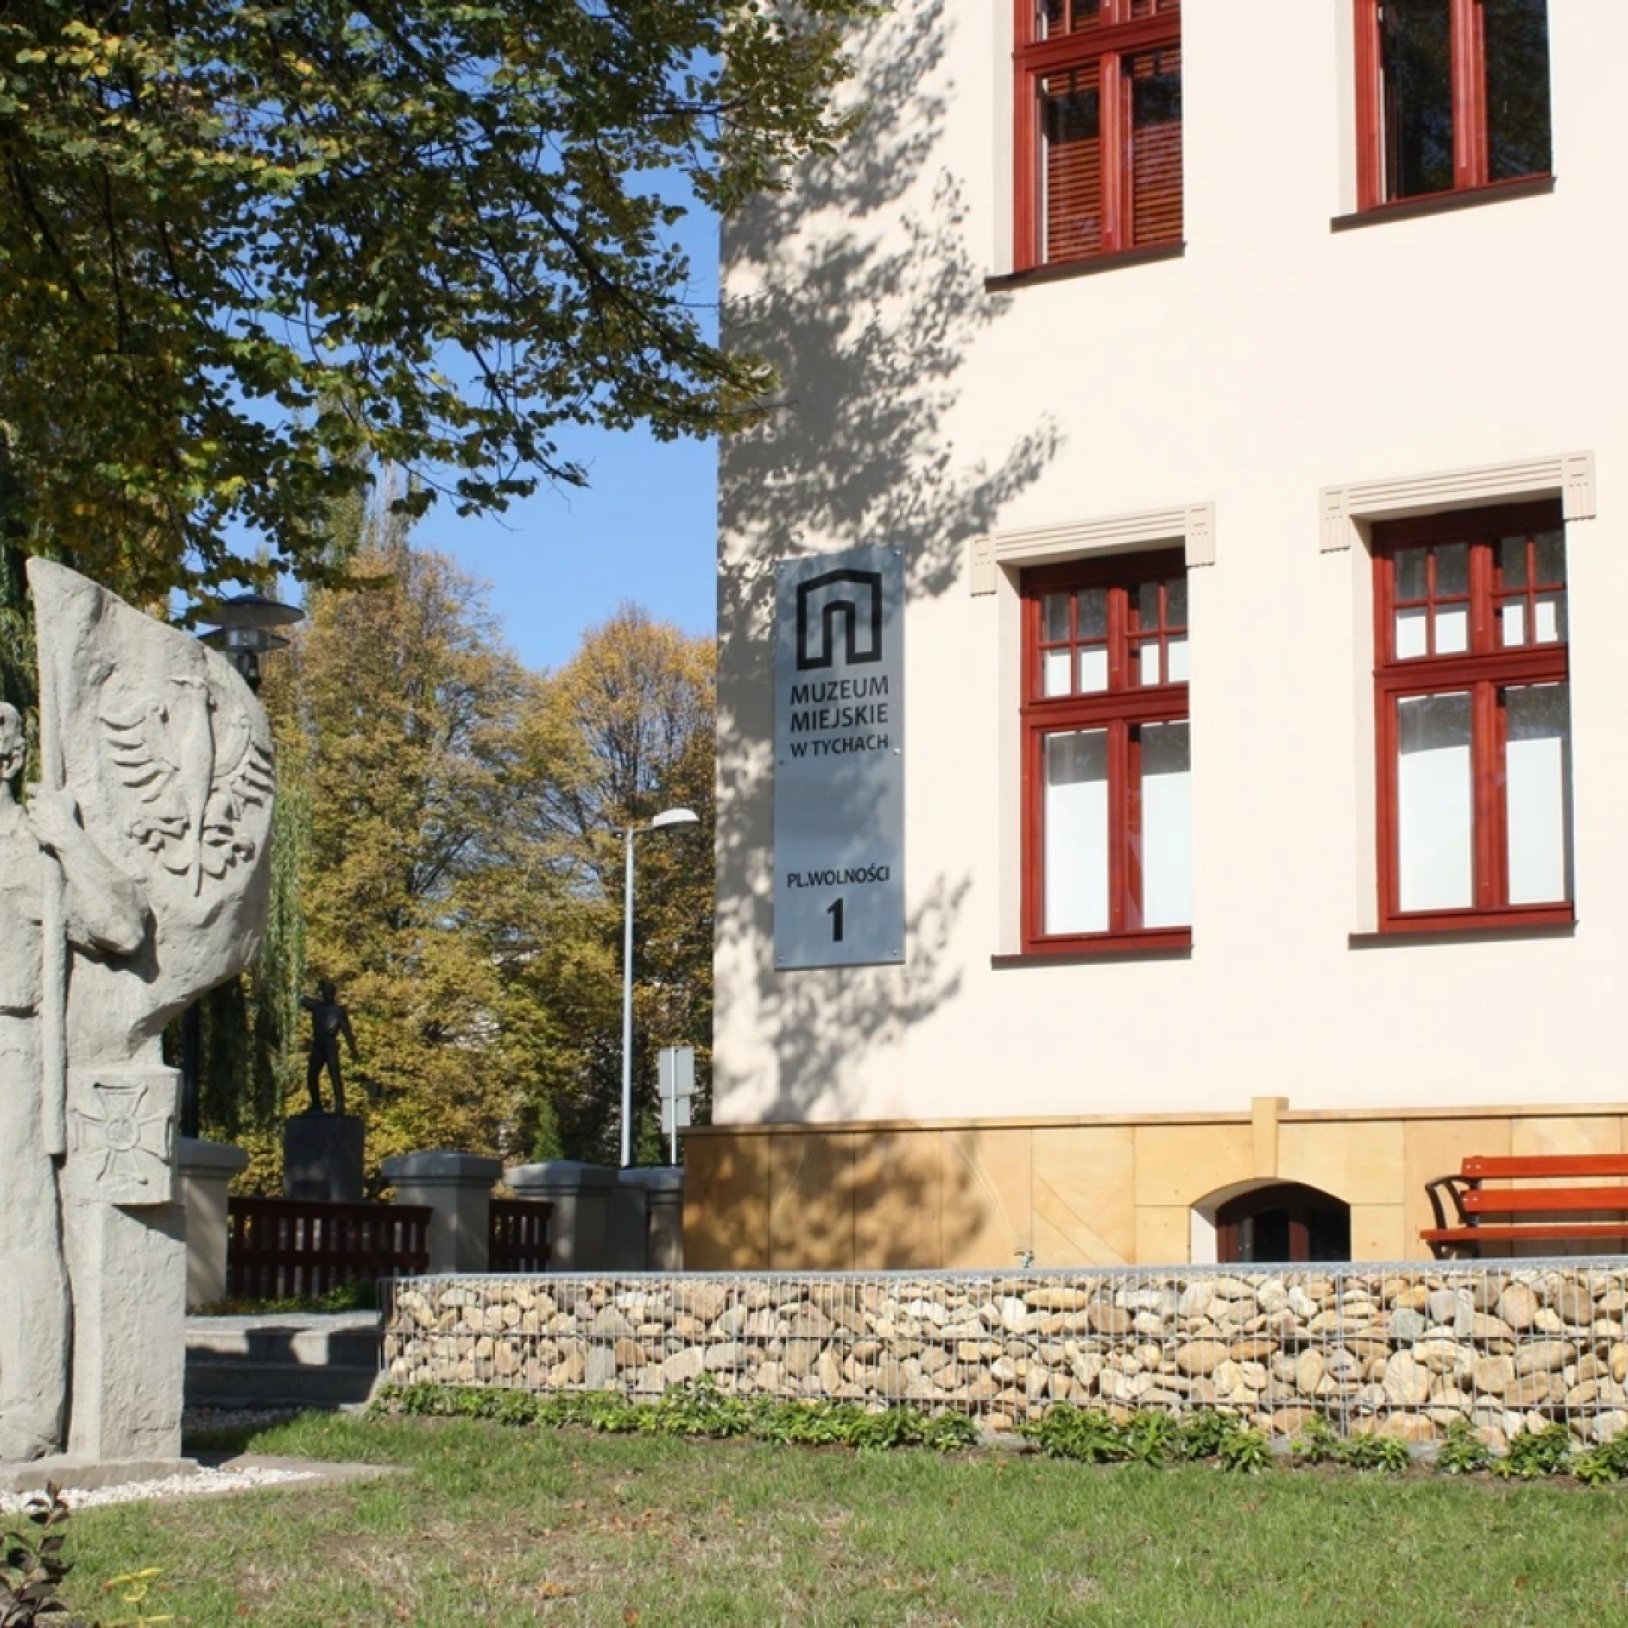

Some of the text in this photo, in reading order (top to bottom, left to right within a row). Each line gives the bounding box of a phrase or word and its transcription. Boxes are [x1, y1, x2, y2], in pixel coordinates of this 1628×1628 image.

[790, 674, 889, 706] MUZEUM
[790, 702, 889, 733] MIEJSKIE
[790, 733, 889, 758] W TYCHACH
[826, 897, 844, 943] 1
